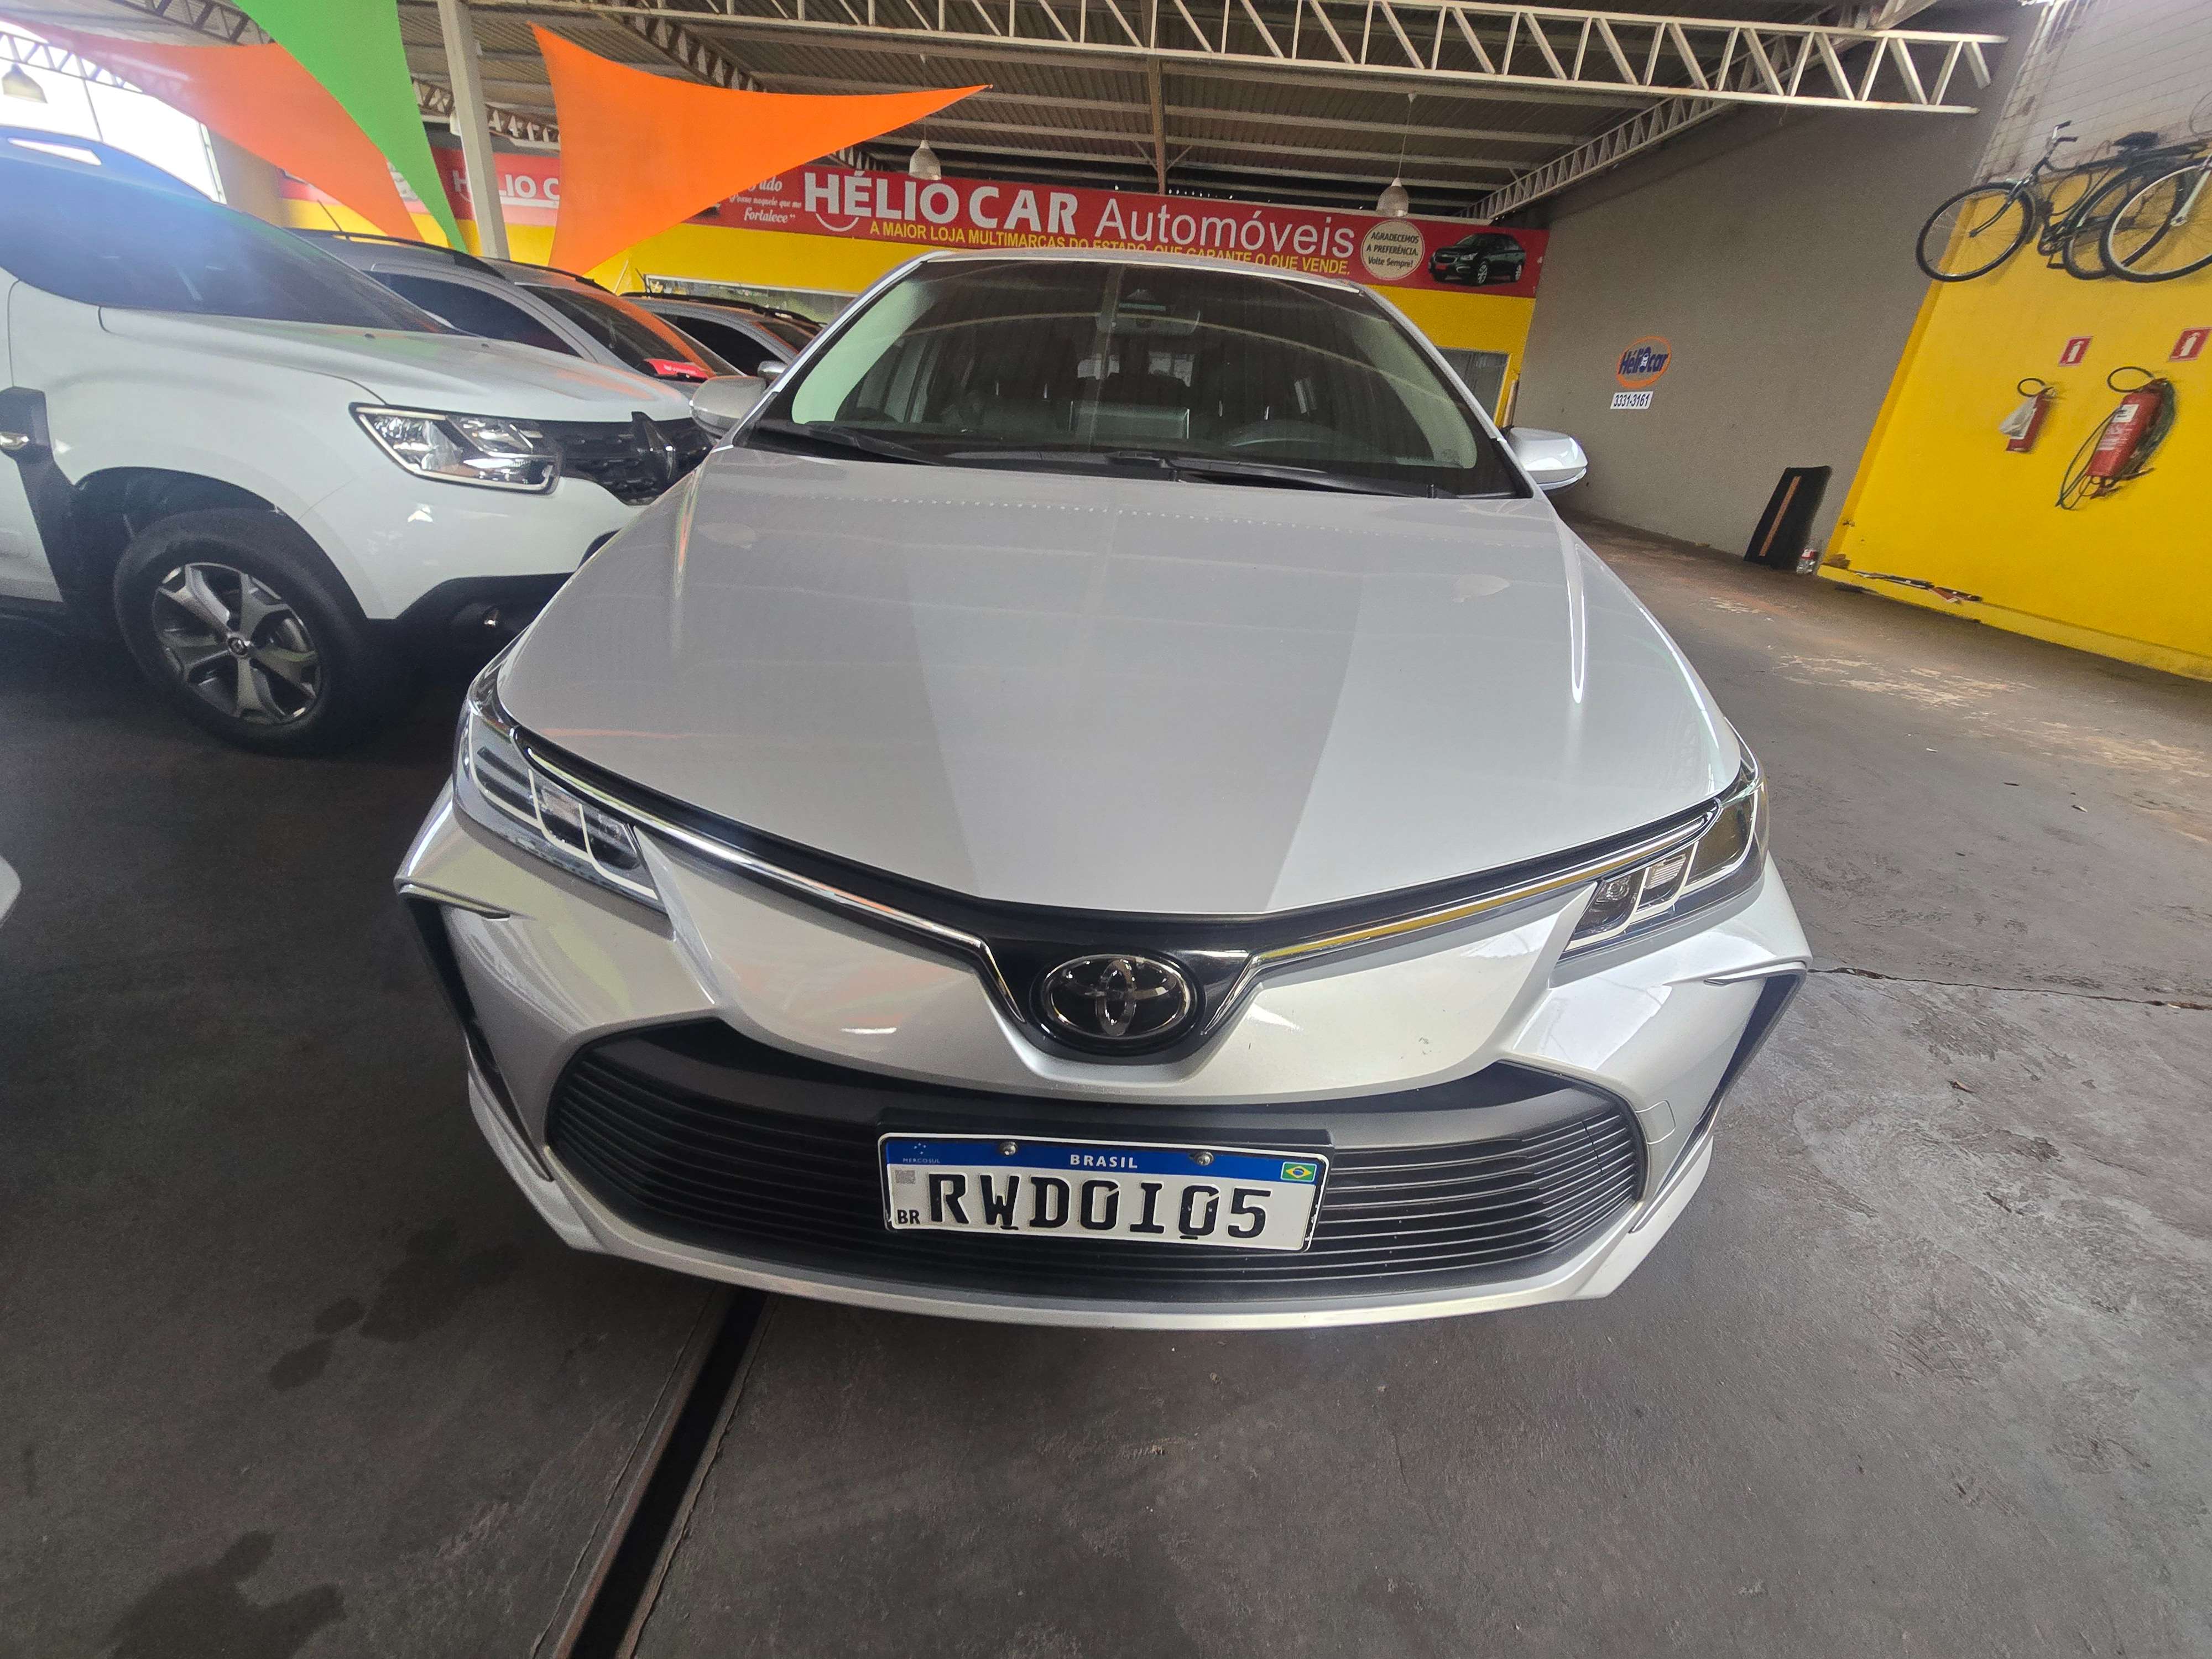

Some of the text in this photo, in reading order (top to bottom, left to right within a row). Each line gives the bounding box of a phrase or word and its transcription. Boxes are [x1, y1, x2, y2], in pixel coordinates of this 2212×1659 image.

[805, 171, 1354, 259] HÉLIO CAR Automóveis
[1371, 232, 1419, 244] AGRADECEMOS
[870, 221, 880, 234] A
[883, 222, 927, 239] MAIOR
[930, 227, 966, 243] LOJA
[968, 229, 1065, 248] MULTIMARCAS
[1070, 238, 1089, 248] DO
[1270, 254, 1298, 270] QUE
[1302, 257, 1350, 275] VENDE.
[1368, 256, 1413, 268] Volte Sempre!
[1614, 393, 1650, 407] 3331-3161
[1070, 1154, 1138, 1169] BRASIL
[897, 1209, 920, 1224] BR
